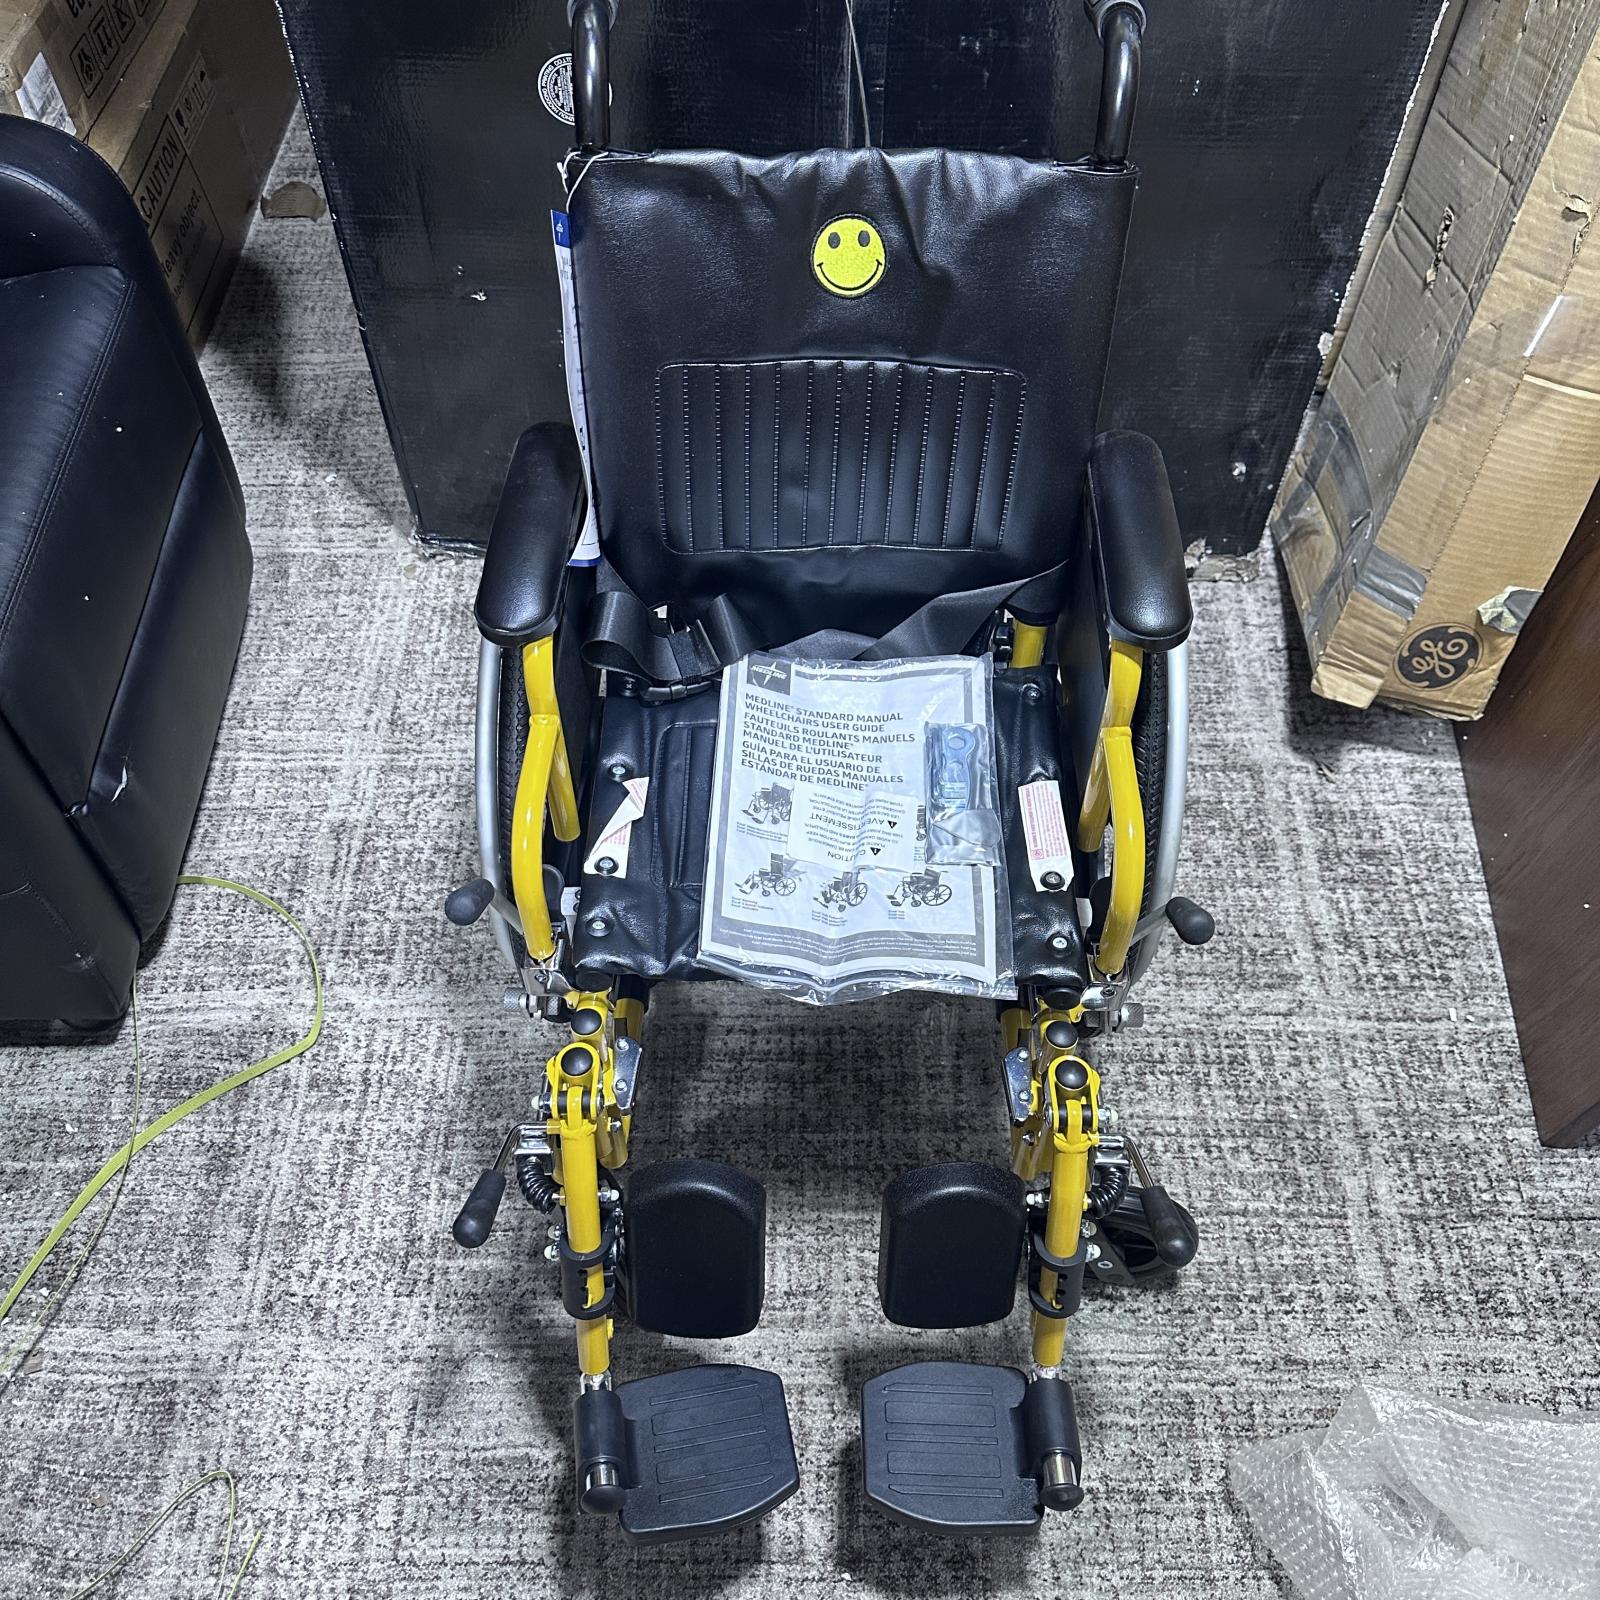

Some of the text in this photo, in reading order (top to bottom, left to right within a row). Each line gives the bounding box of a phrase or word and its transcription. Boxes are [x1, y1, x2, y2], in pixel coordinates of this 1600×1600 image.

[140, 132, 180, 220] CAUTION
[751, 665, 788, 680] MEDLINE
[744, 701, 885, 733] WHEELCHAIRS USER GUIDE
[745, 693, 904, 723] MEDLINE STANDARD MANUAL
[743, 720, 852, 750] STANDARD MEDLINE
[744, 712, 916, 744] FAUTEUILS ROULANTS MANUELS
[743, 729, 883, 764] MANUEL DE L'UTILISATEUR
[769, 748, 798, 763] PARA
[800, 756, 813, 765] EL
[815, 758, 864, 773] USUARIO
[866, 765, 881, 774] DE
[741, 749, 904, 783] SILLAS DE RUEDAS MANUALES
[799, 774, 814, 784] DE
[816, 776, 866, 791] MEDLINE
[809, 812, 885, 831] AVERTISSEMENT
